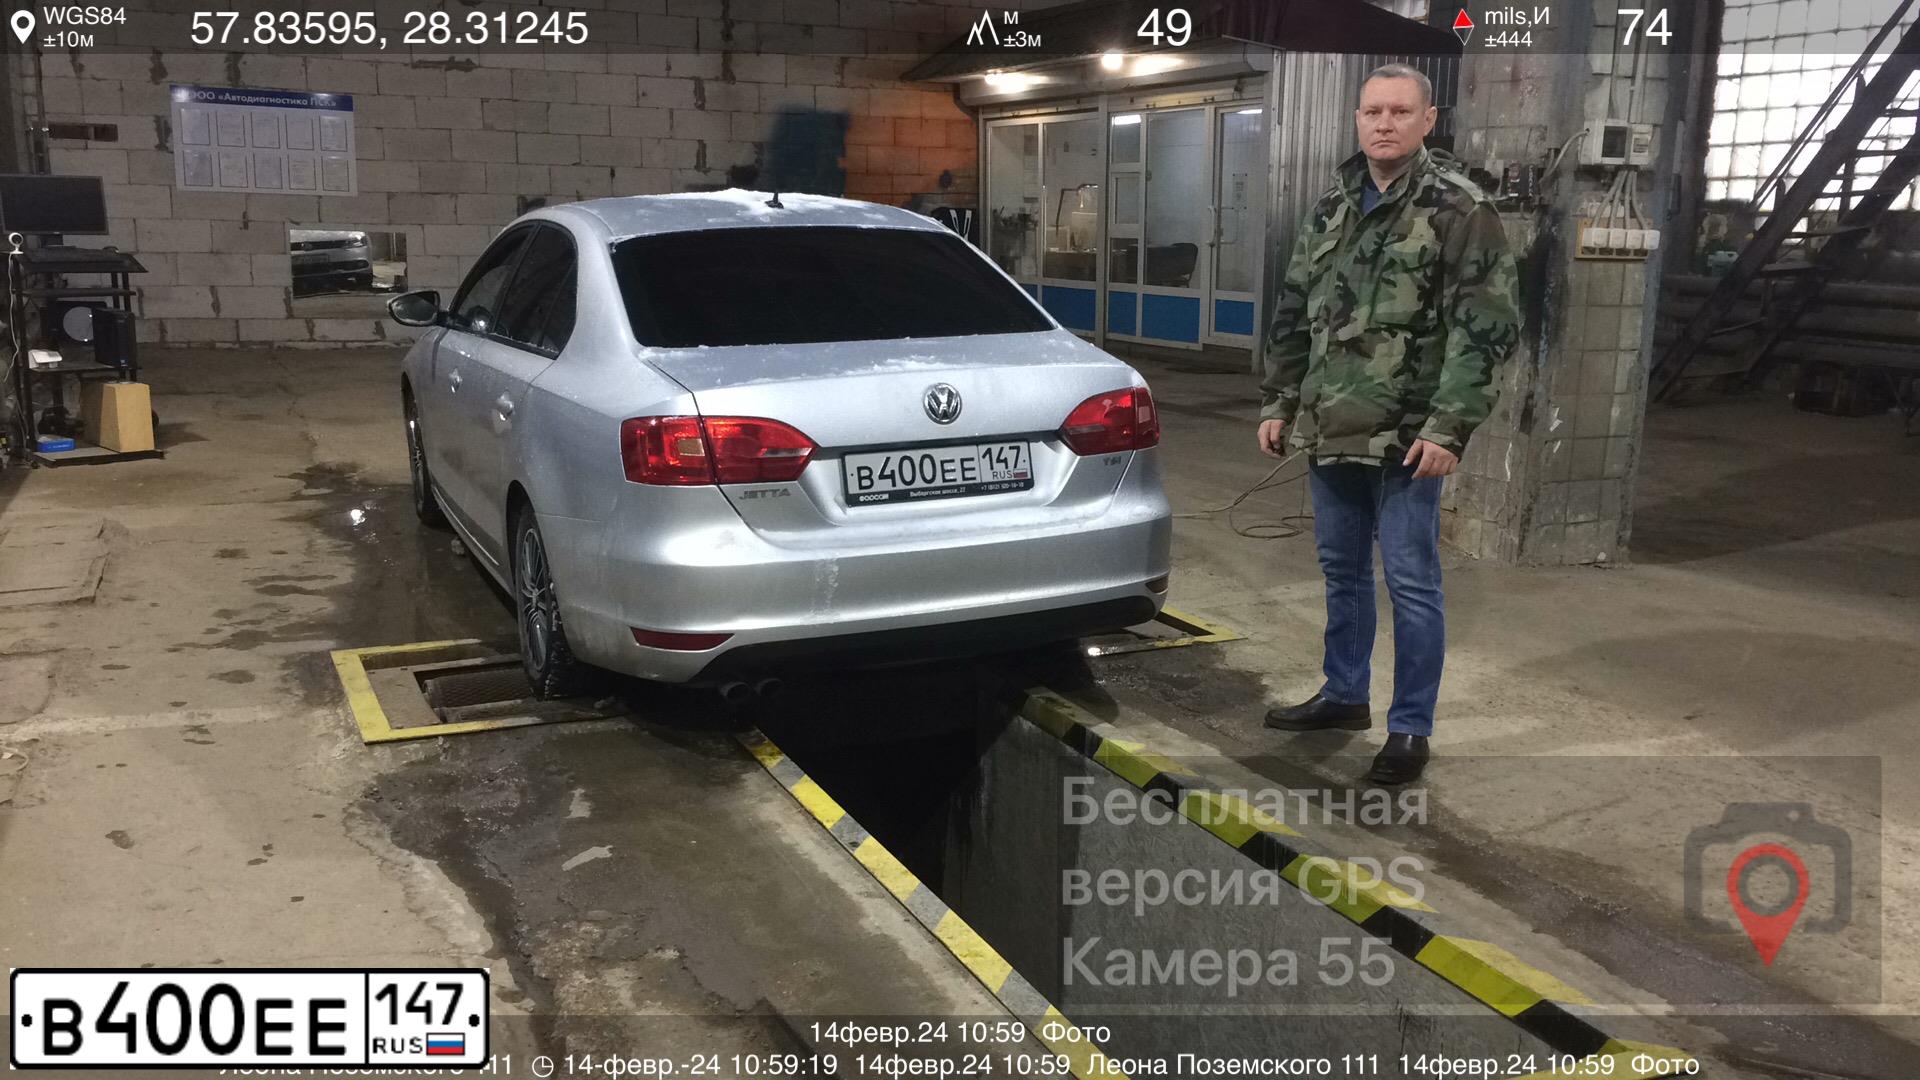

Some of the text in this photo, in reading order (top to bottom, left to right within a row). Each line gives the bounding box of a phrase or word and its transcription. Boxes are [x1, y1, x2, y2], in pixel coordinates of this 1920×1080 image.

[981, 445, 1021, 470] 147
[992, 470, 1012, 480] RUS
[739, 488, 791, 500] JETTA
